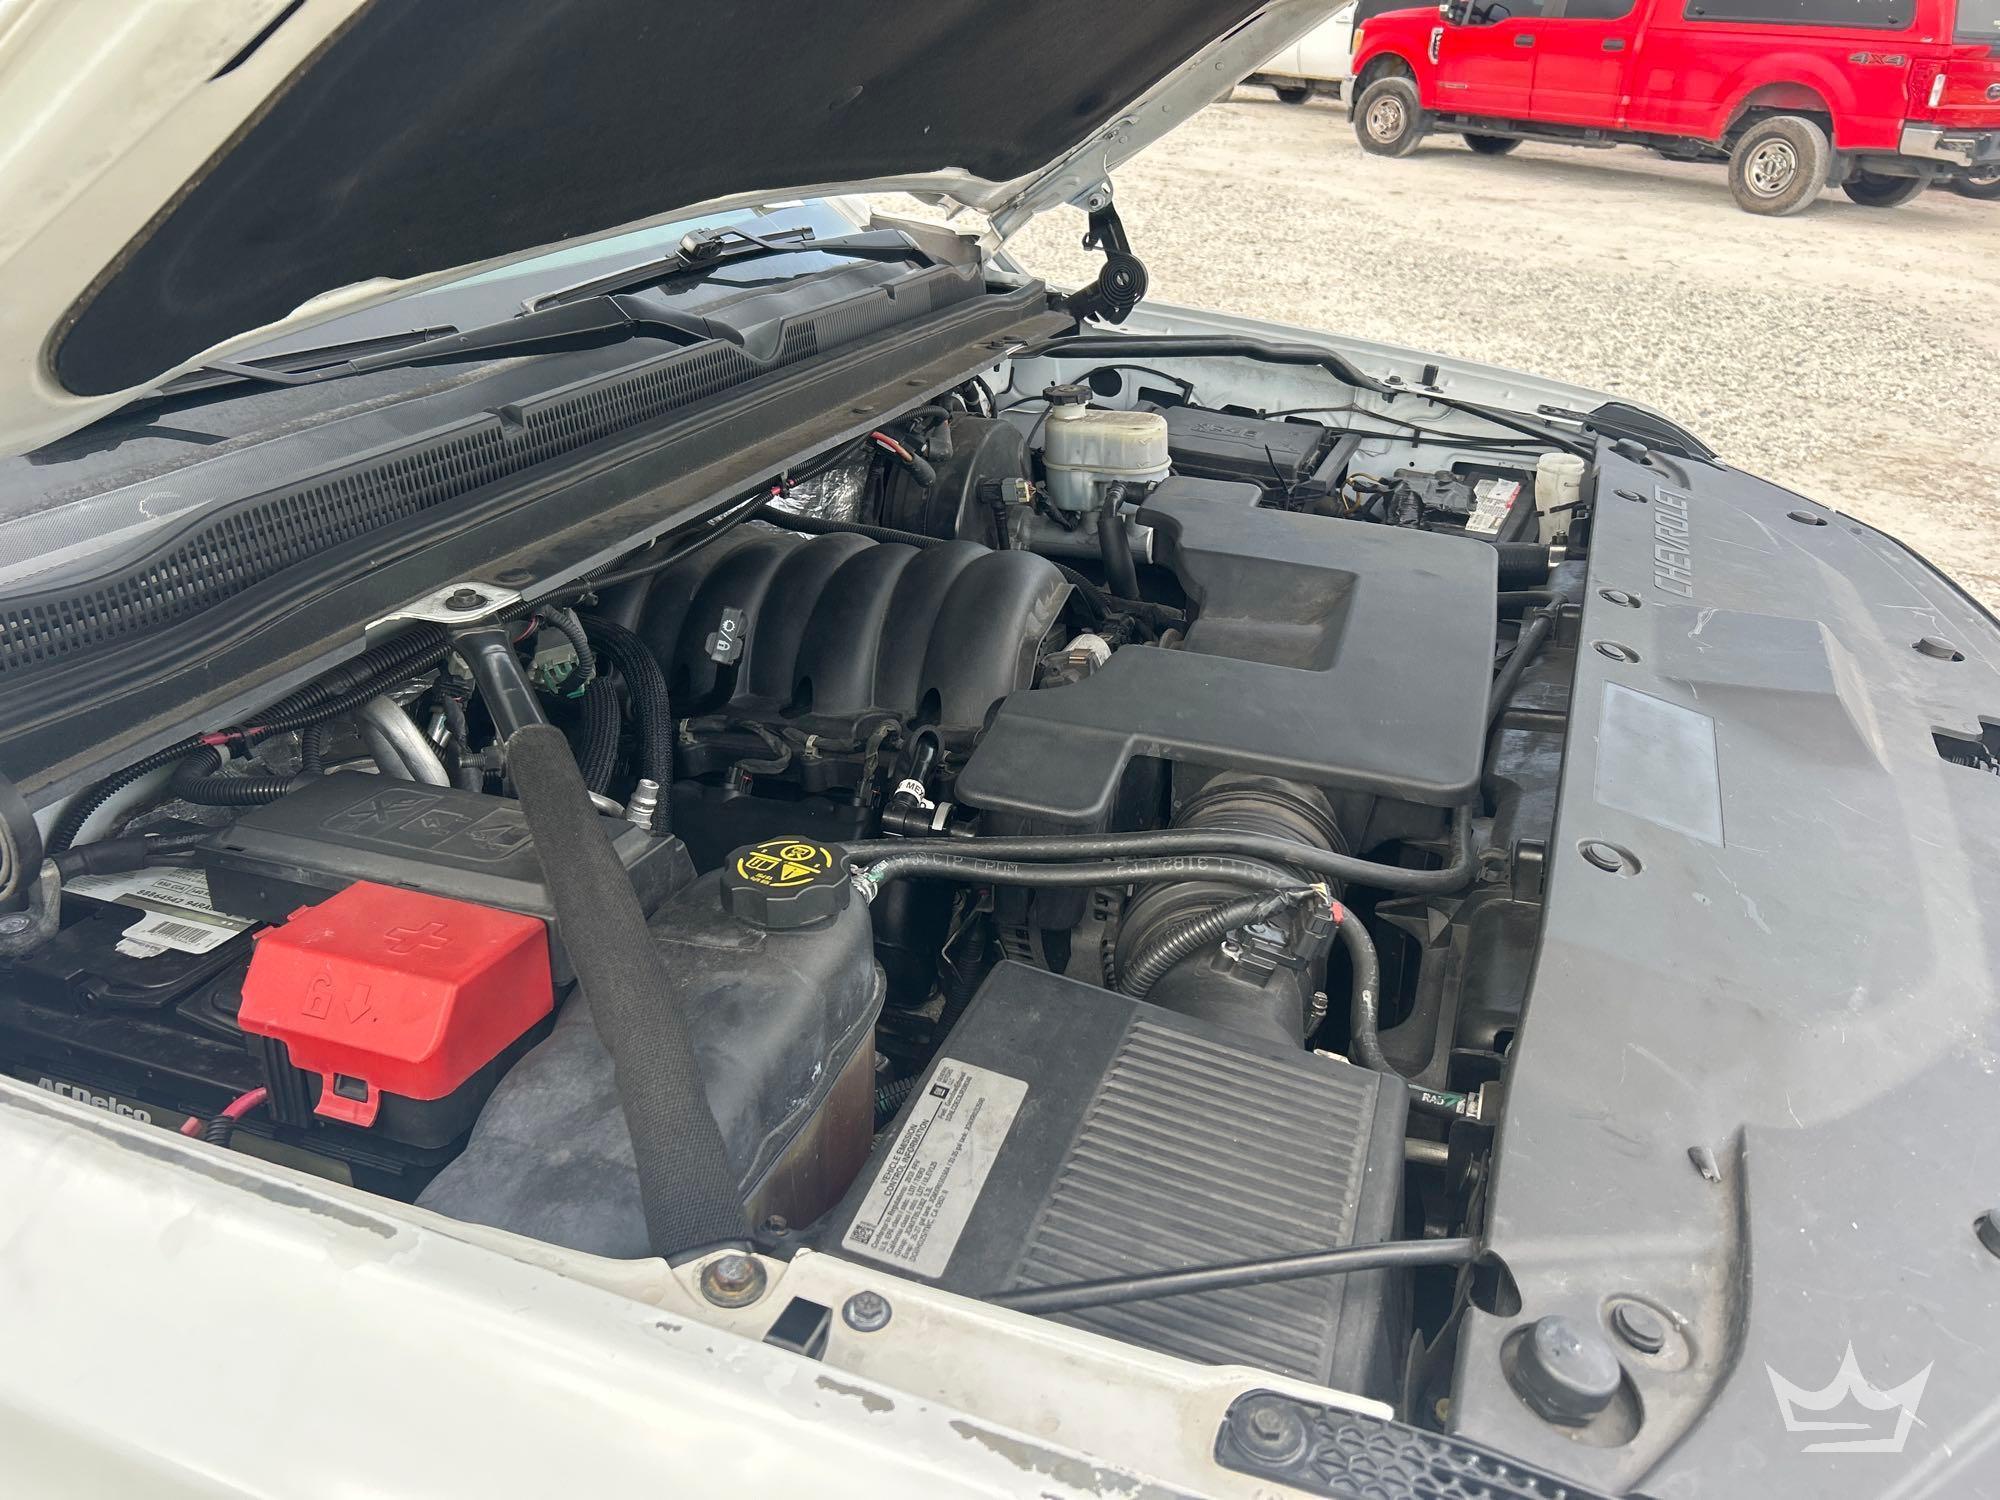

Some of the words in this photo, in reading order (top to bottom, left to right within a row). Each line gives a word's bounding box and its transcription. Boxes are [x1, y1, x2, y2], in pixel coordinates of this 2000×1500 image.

[1654, 484, 1693, 599] CHEVROLET
[1422, 1092, 1445, 1106] RAD
[881, 1154, 901, 1184] VEHICLE
[897, 1123, 918, 1154] EMISSION
[884, 1162, 907, 1196] CONTROL
[903, 1119, 929, 1162] INFORMATION
